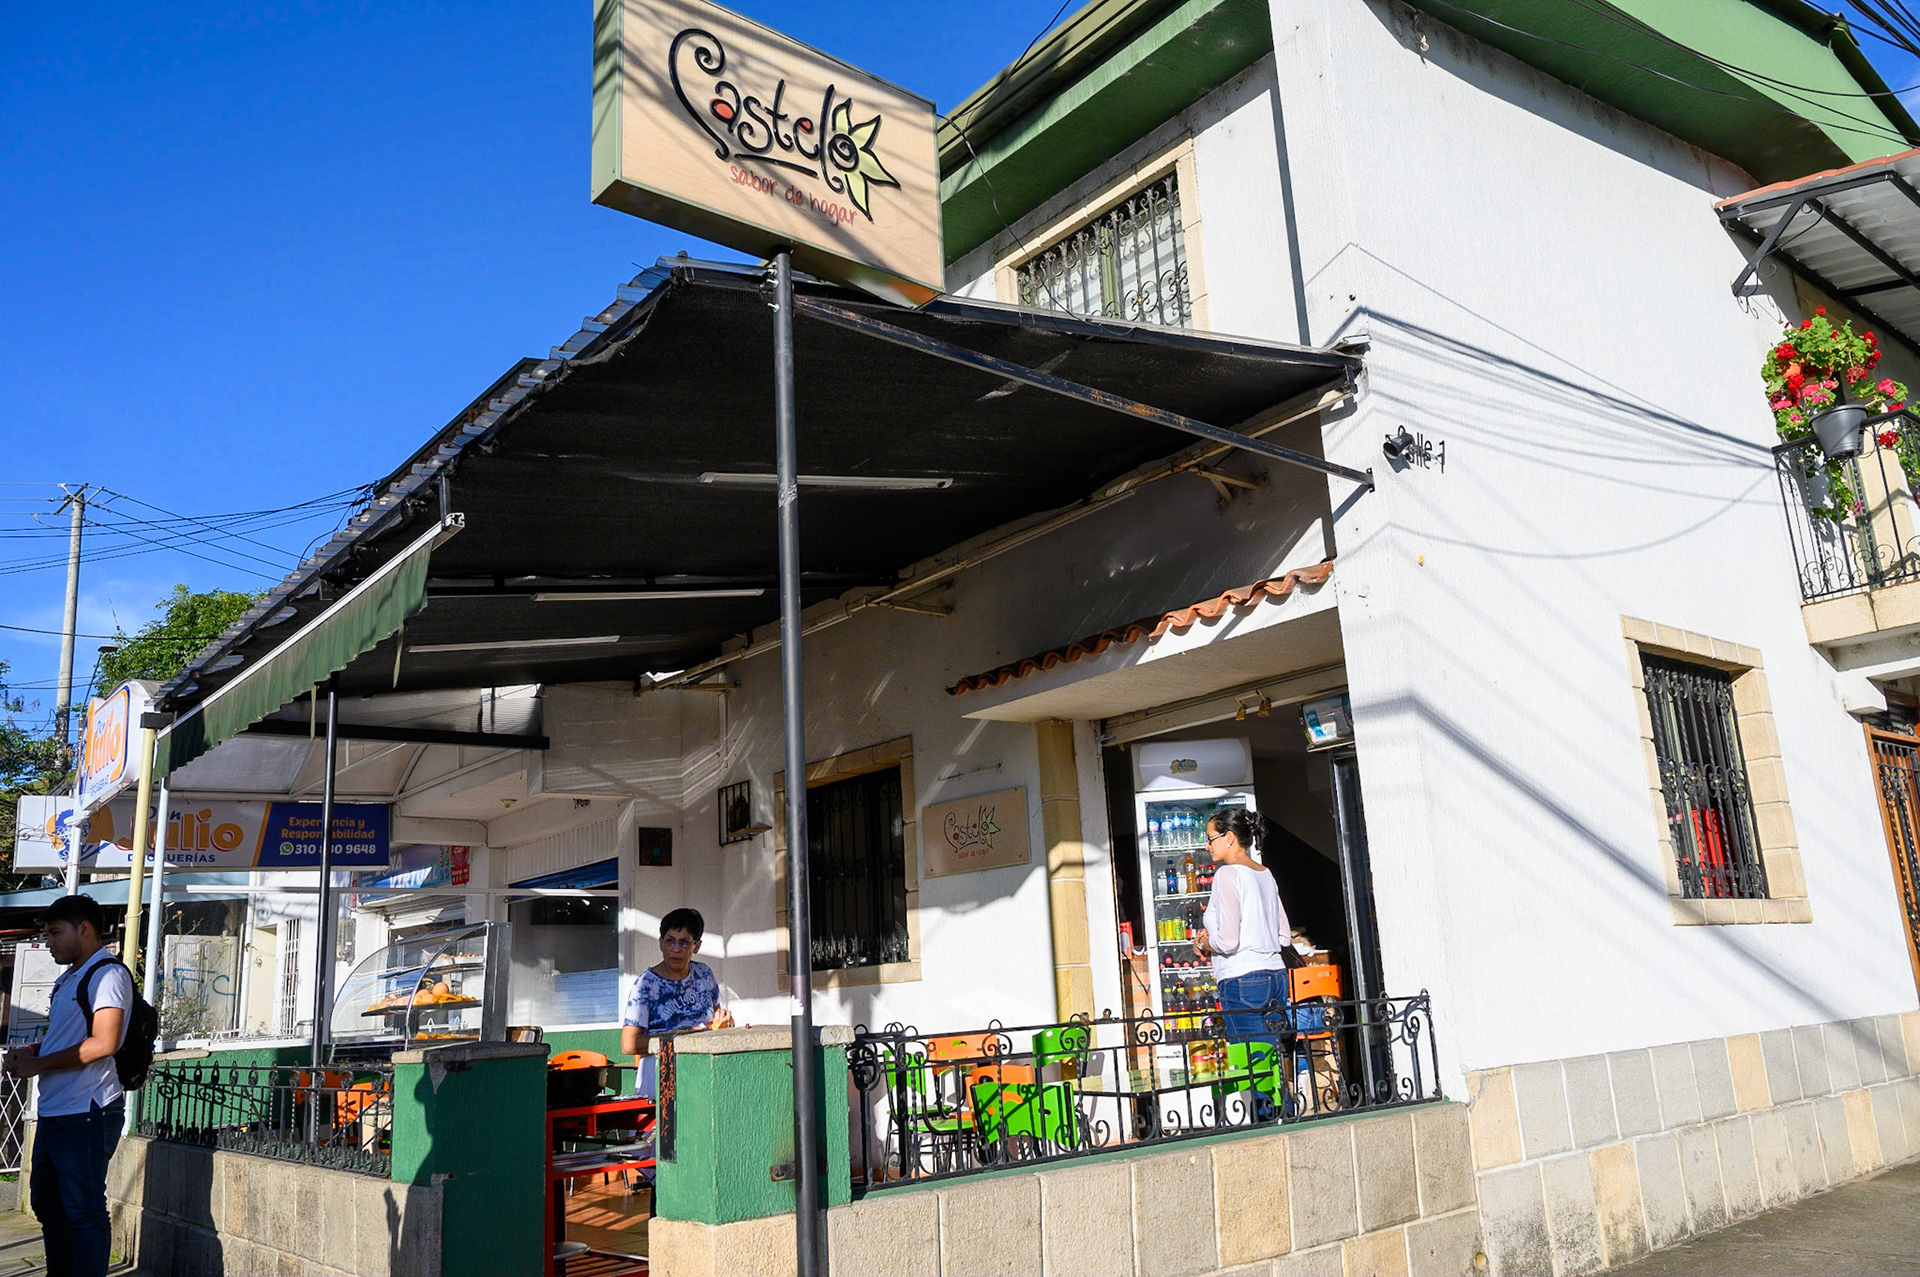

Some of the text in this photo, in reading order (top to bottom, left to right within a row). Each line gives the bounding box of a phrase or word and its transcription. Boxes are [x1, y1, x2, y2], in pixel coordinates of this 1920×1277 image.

[668, 28, 862, 193] Castelo
[730, 165, 857, 226] sabor de hogar
[281, 828, 375, 840] Responabilidad
[357, 819, 366, 829] y
[944, 805, 991, 853] Castelo
[295, 844, 316, 854] 310
[345, 844, 376, 854] 9648
